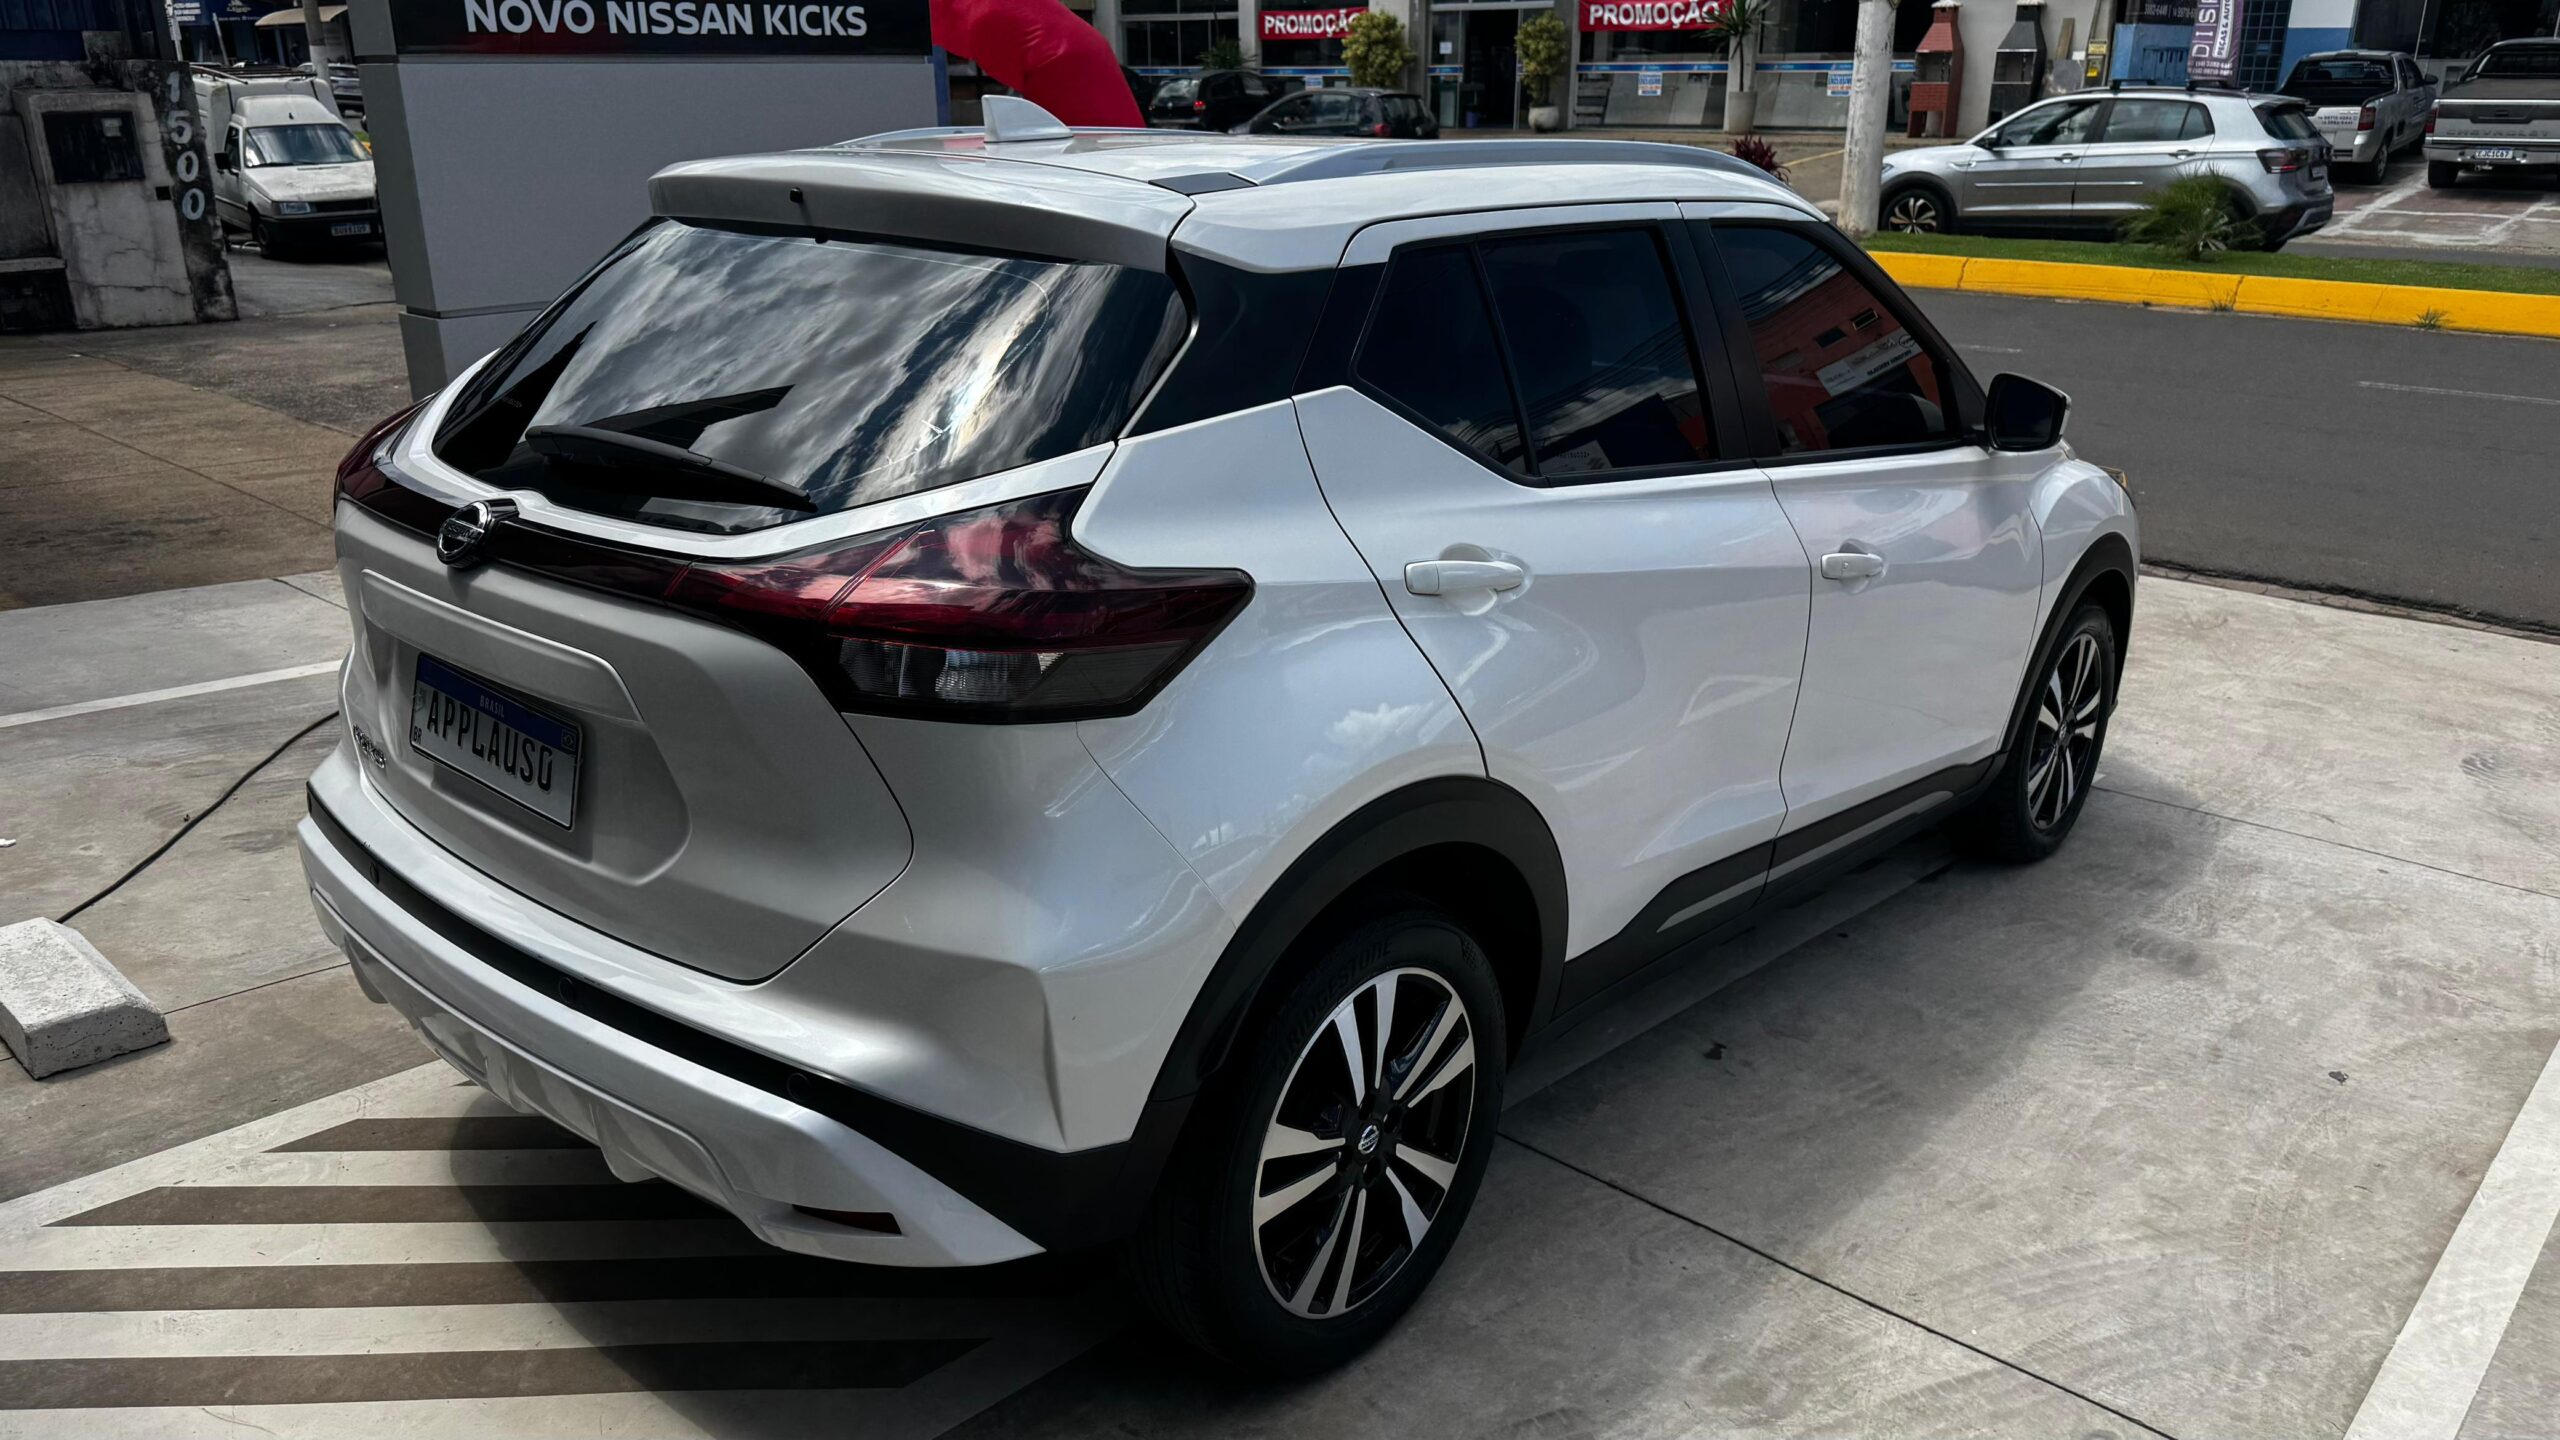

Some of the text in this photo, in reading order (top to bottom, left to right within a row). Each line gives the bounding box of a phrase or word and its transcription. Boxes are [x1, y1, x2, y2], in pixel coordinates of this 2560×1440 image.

[465, 0, 868, 37] NOVO NISSAN KICKS
[166, 71, 205, 221] 1500
[2446, 129, 2550, 137] CHEVROLET
[479, 694, 506, 719] BRASIL
[412, 725, 423, 745] BR
[427, 690, 555, 794] APPLAUSO
